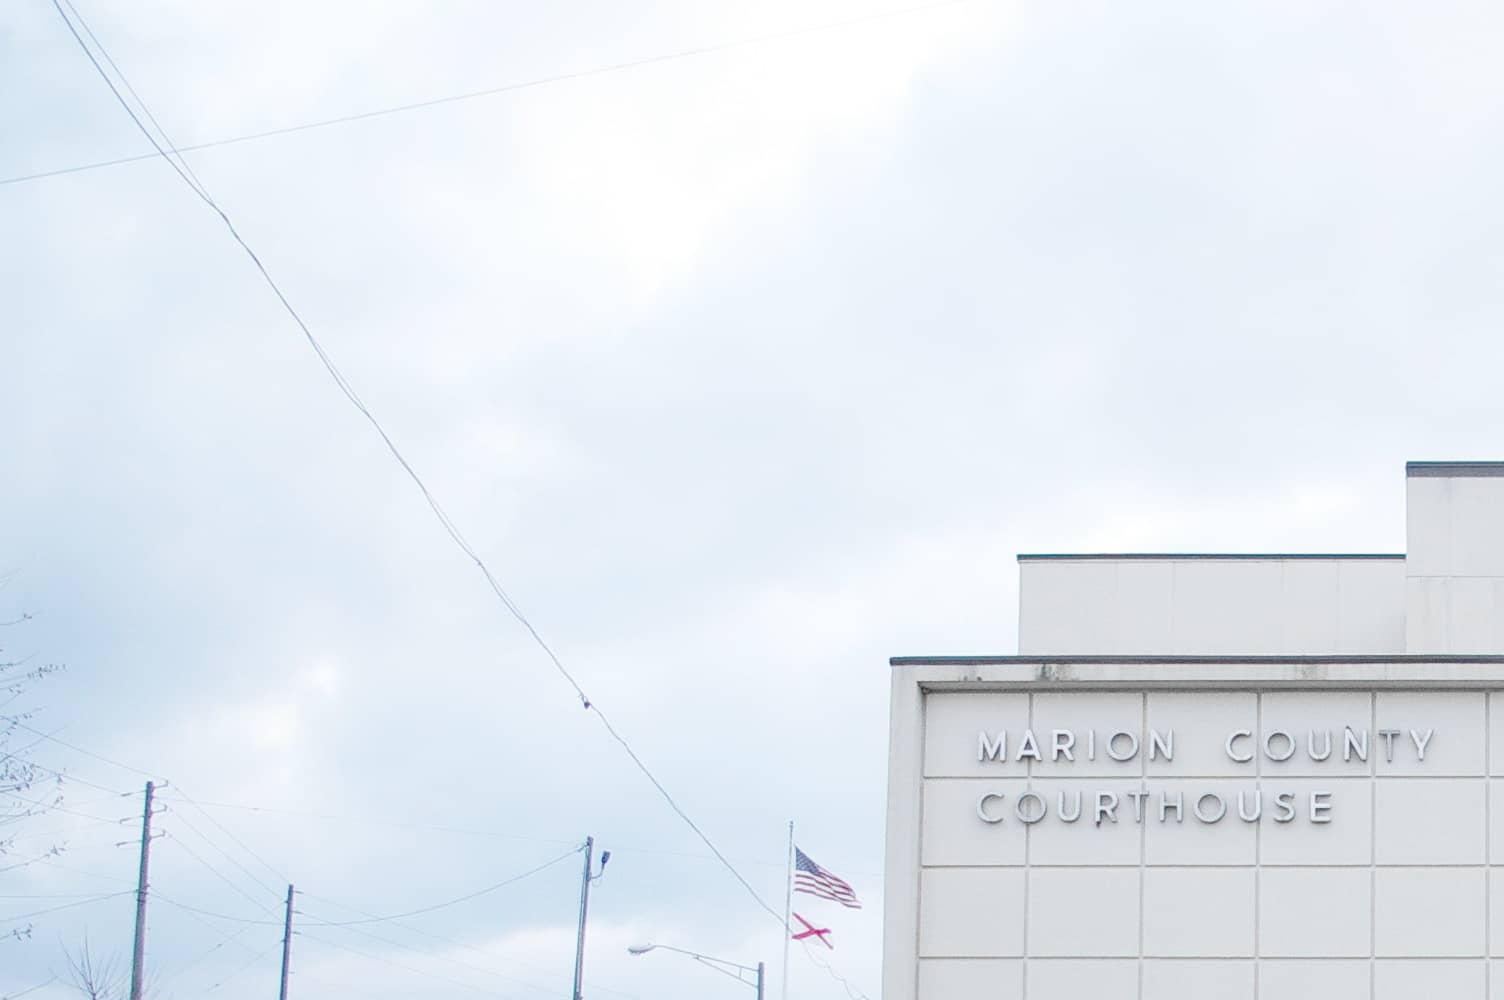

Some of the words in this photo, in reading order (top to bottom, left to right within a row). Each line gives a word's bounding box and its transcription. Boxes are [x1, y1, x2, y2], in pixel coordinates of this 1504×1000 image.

[977, 728, 1175, 763] MARION
[1224, 727, 1435, 762] COUNTY
[976, 790, 1333, 825] COURTHOUSE
